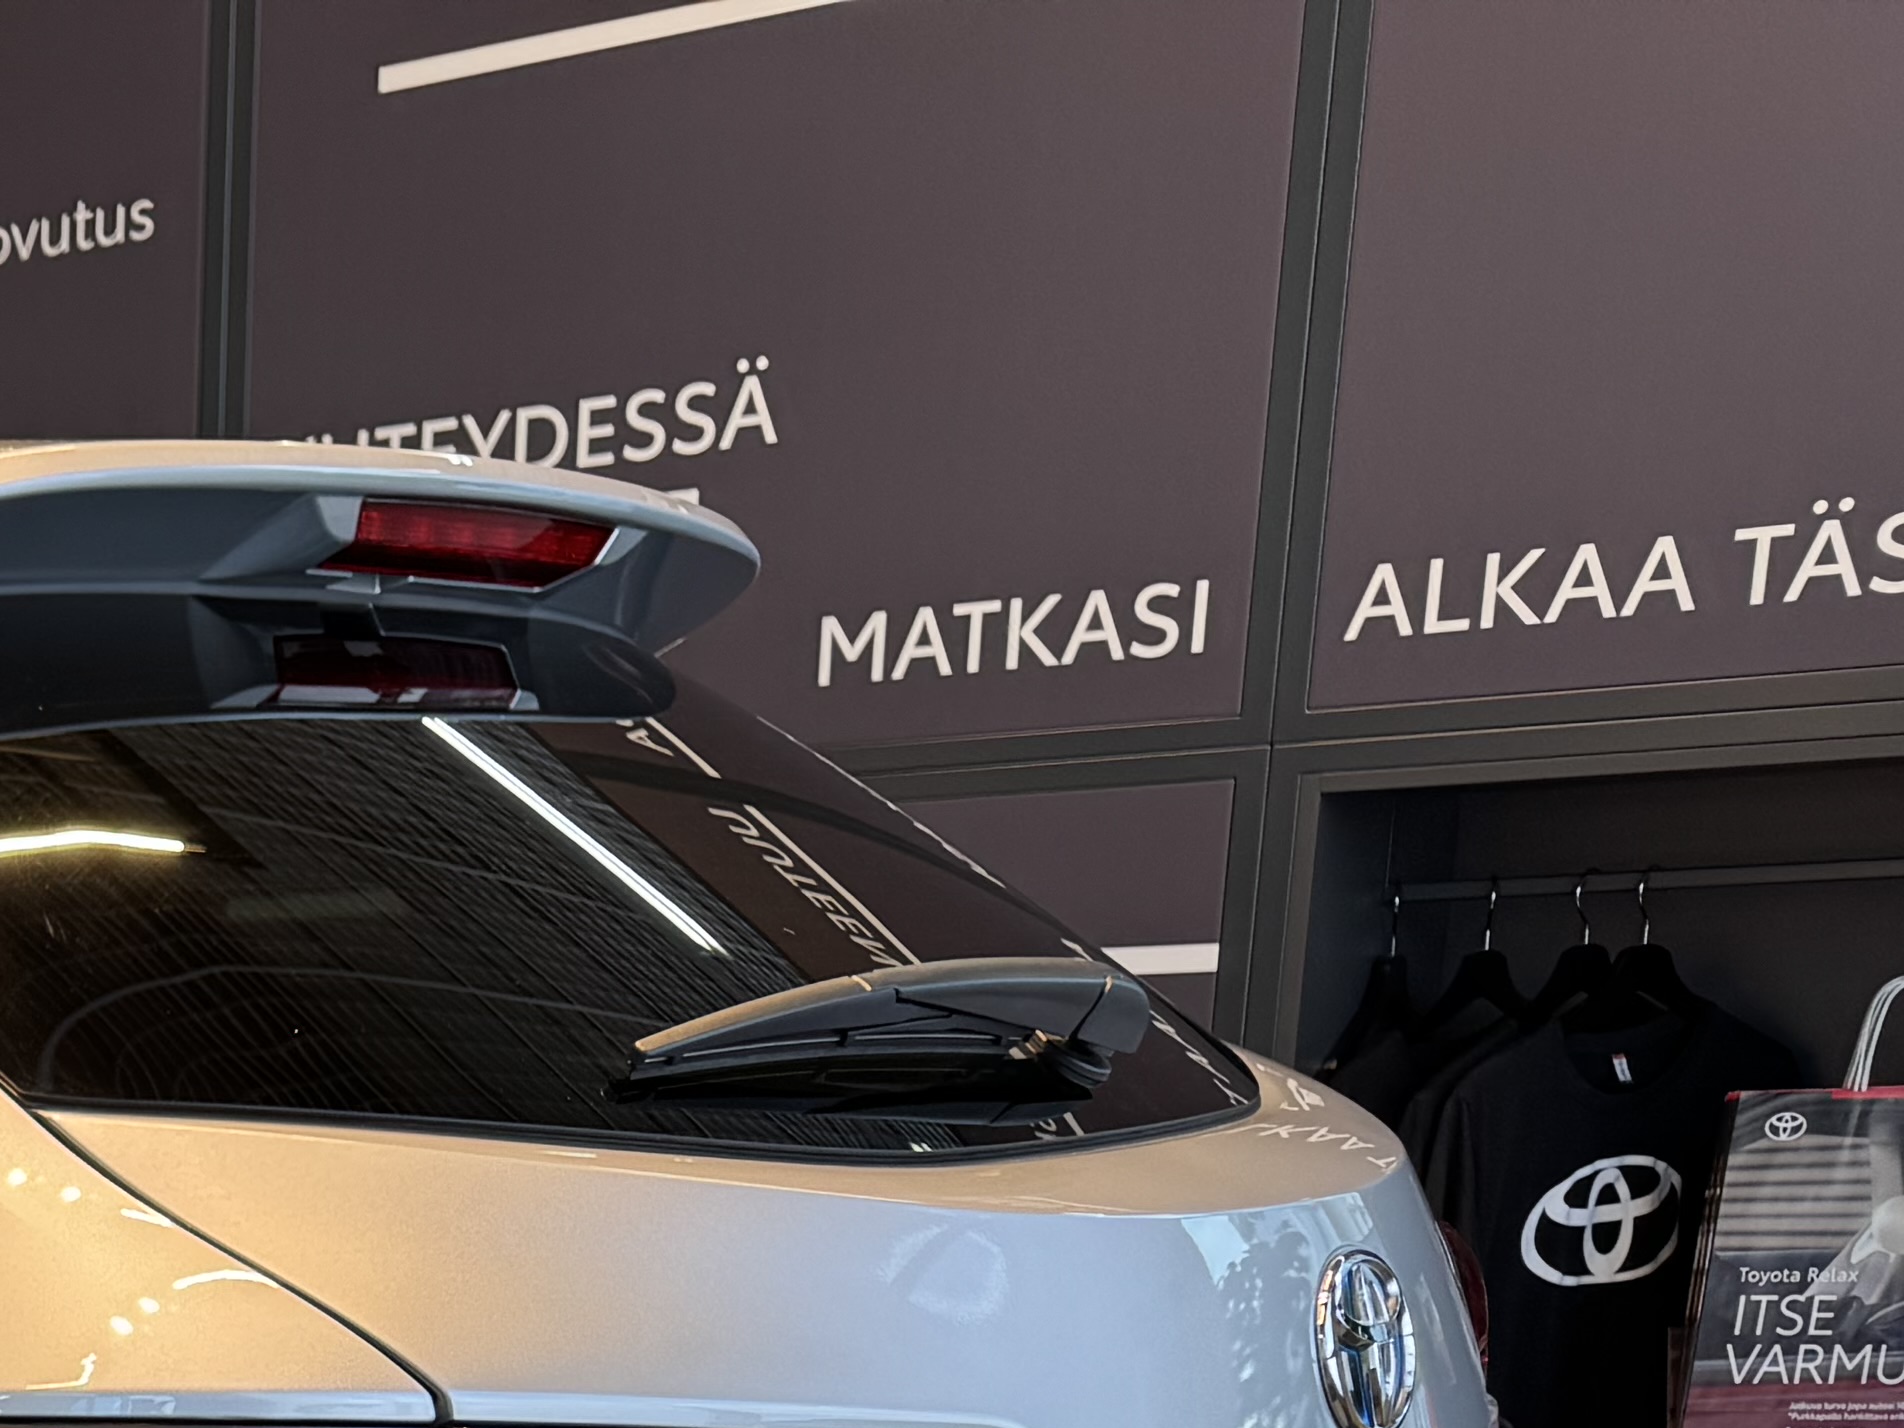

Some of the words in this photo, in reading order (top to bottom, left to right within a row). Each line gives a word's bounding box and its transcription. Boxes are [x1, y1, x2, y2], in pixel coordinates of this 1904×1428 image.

[1343, 534, 1695, 643] ALKAA
[816, 578, 1212, 687] MATKASI
[1740, 1266, 1800, 1287] Toyota
[1807, 1267, 1859, 1283] Relax
[1733, 1294, 1838, 1336] ITSE
[1726, 1343, 1904, 1386] VARMU
